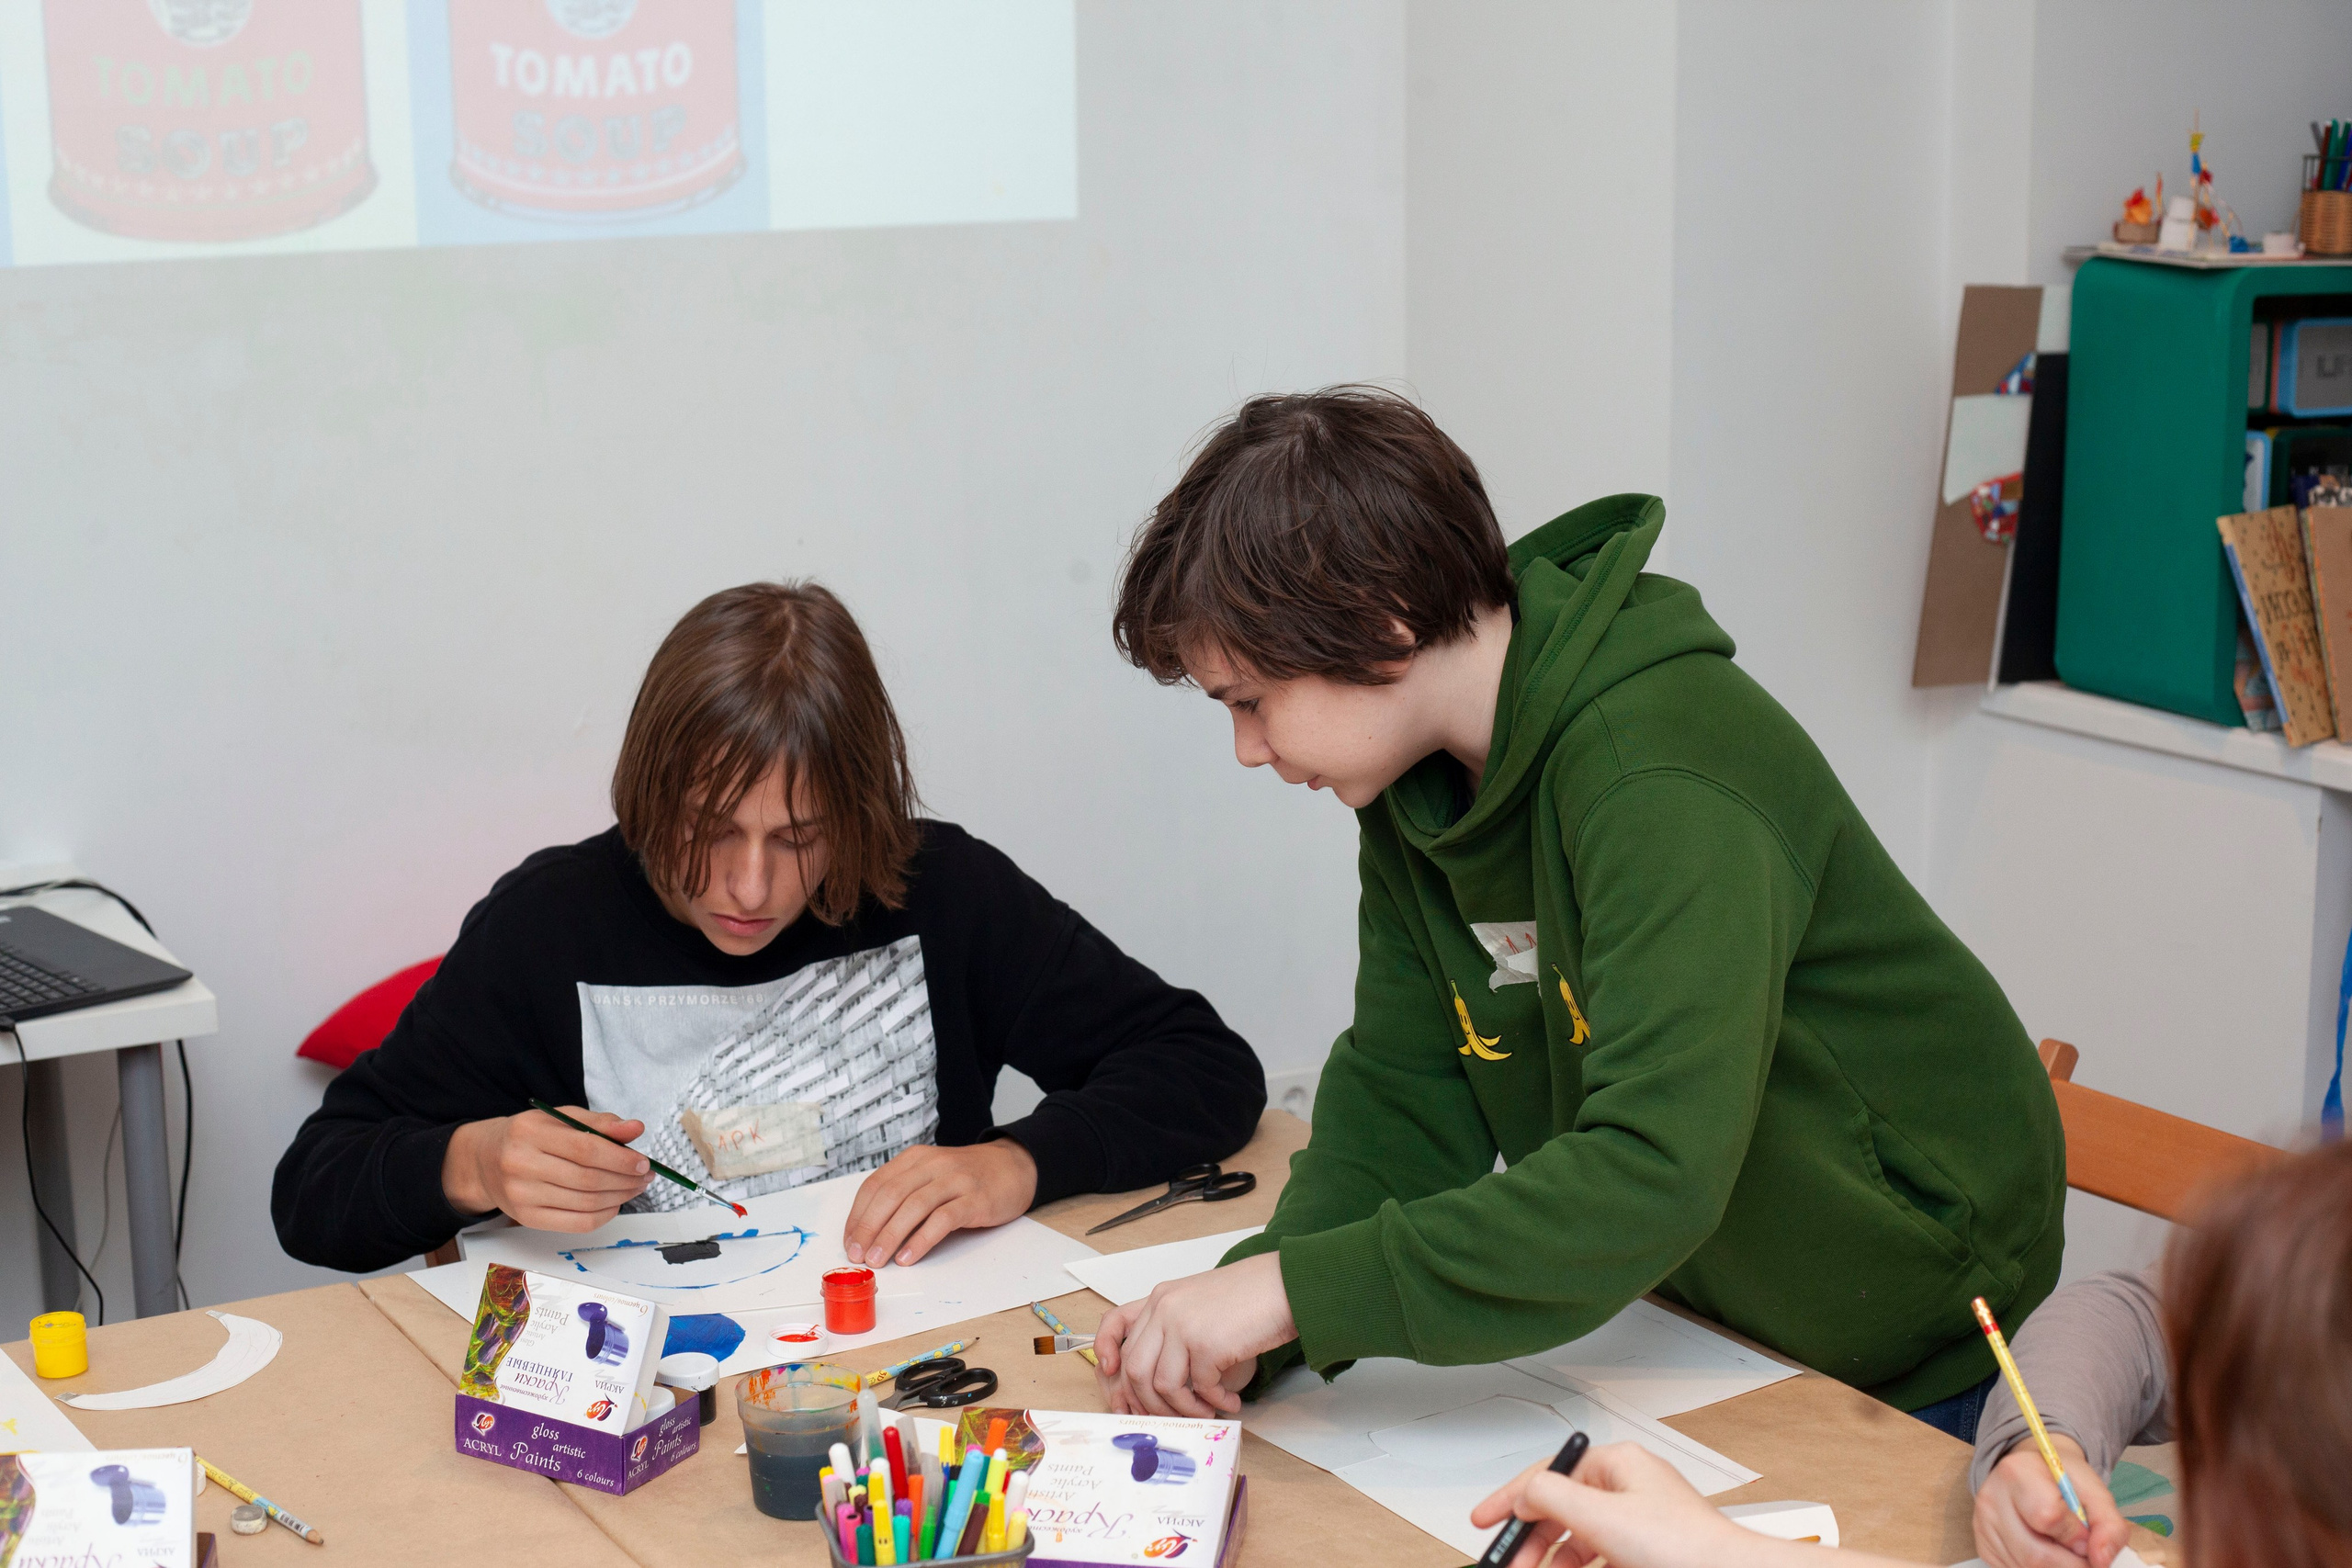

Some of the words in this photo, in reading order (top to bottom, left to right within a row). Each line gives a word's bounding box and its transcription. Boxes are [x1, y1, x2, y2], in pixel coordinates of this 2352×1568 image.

[93, 50, 314, 107] TOMATO
[489, 41, 694, 97] TOMATO
[512, 104, 687, 164] SOUP
[114, 117, 310, 180] SOUP
[593, 992, 643, 1007] DAŃSK
[648, 994, 739, 1007] PRZYMORZE
[534, 1306, 571, 1326] Paints
[637, 1304, 650, 1318] 6
[529, 1320, 560, 1335] Acrylic
[505, 1356, 574, 1382] ГЛЯНЦЕВЫЕ
[514, 1371, 570, 1405] Краски
[594, 1380, 626, 1394] АКРИЛ
[531, 1422, 560, 1440] gloss
[658, 1416, 676, 1438] gloss
[462, 1437, 503, 1458] ACRYL
[509, 1440, 562, 1472] Paints
[552, 1442, 587, 1460] artistic
[650, 1433, 683, 1461] Paints
[576, 1469, 583, 1480] 6
[584, 1472, 615, 1487] colours
[627, 1460, 650, 1481] ACRYL
[1047, 1463, 1096, 1476] Paints
[1049, 1477, 1103, 1491] Acrylic
[1027, 1489, 1077, 1502] Artisti
[1027, 1501, 1135, 1540] Краск
[1157, 1516, 1205, 1529] АКРИЛ
